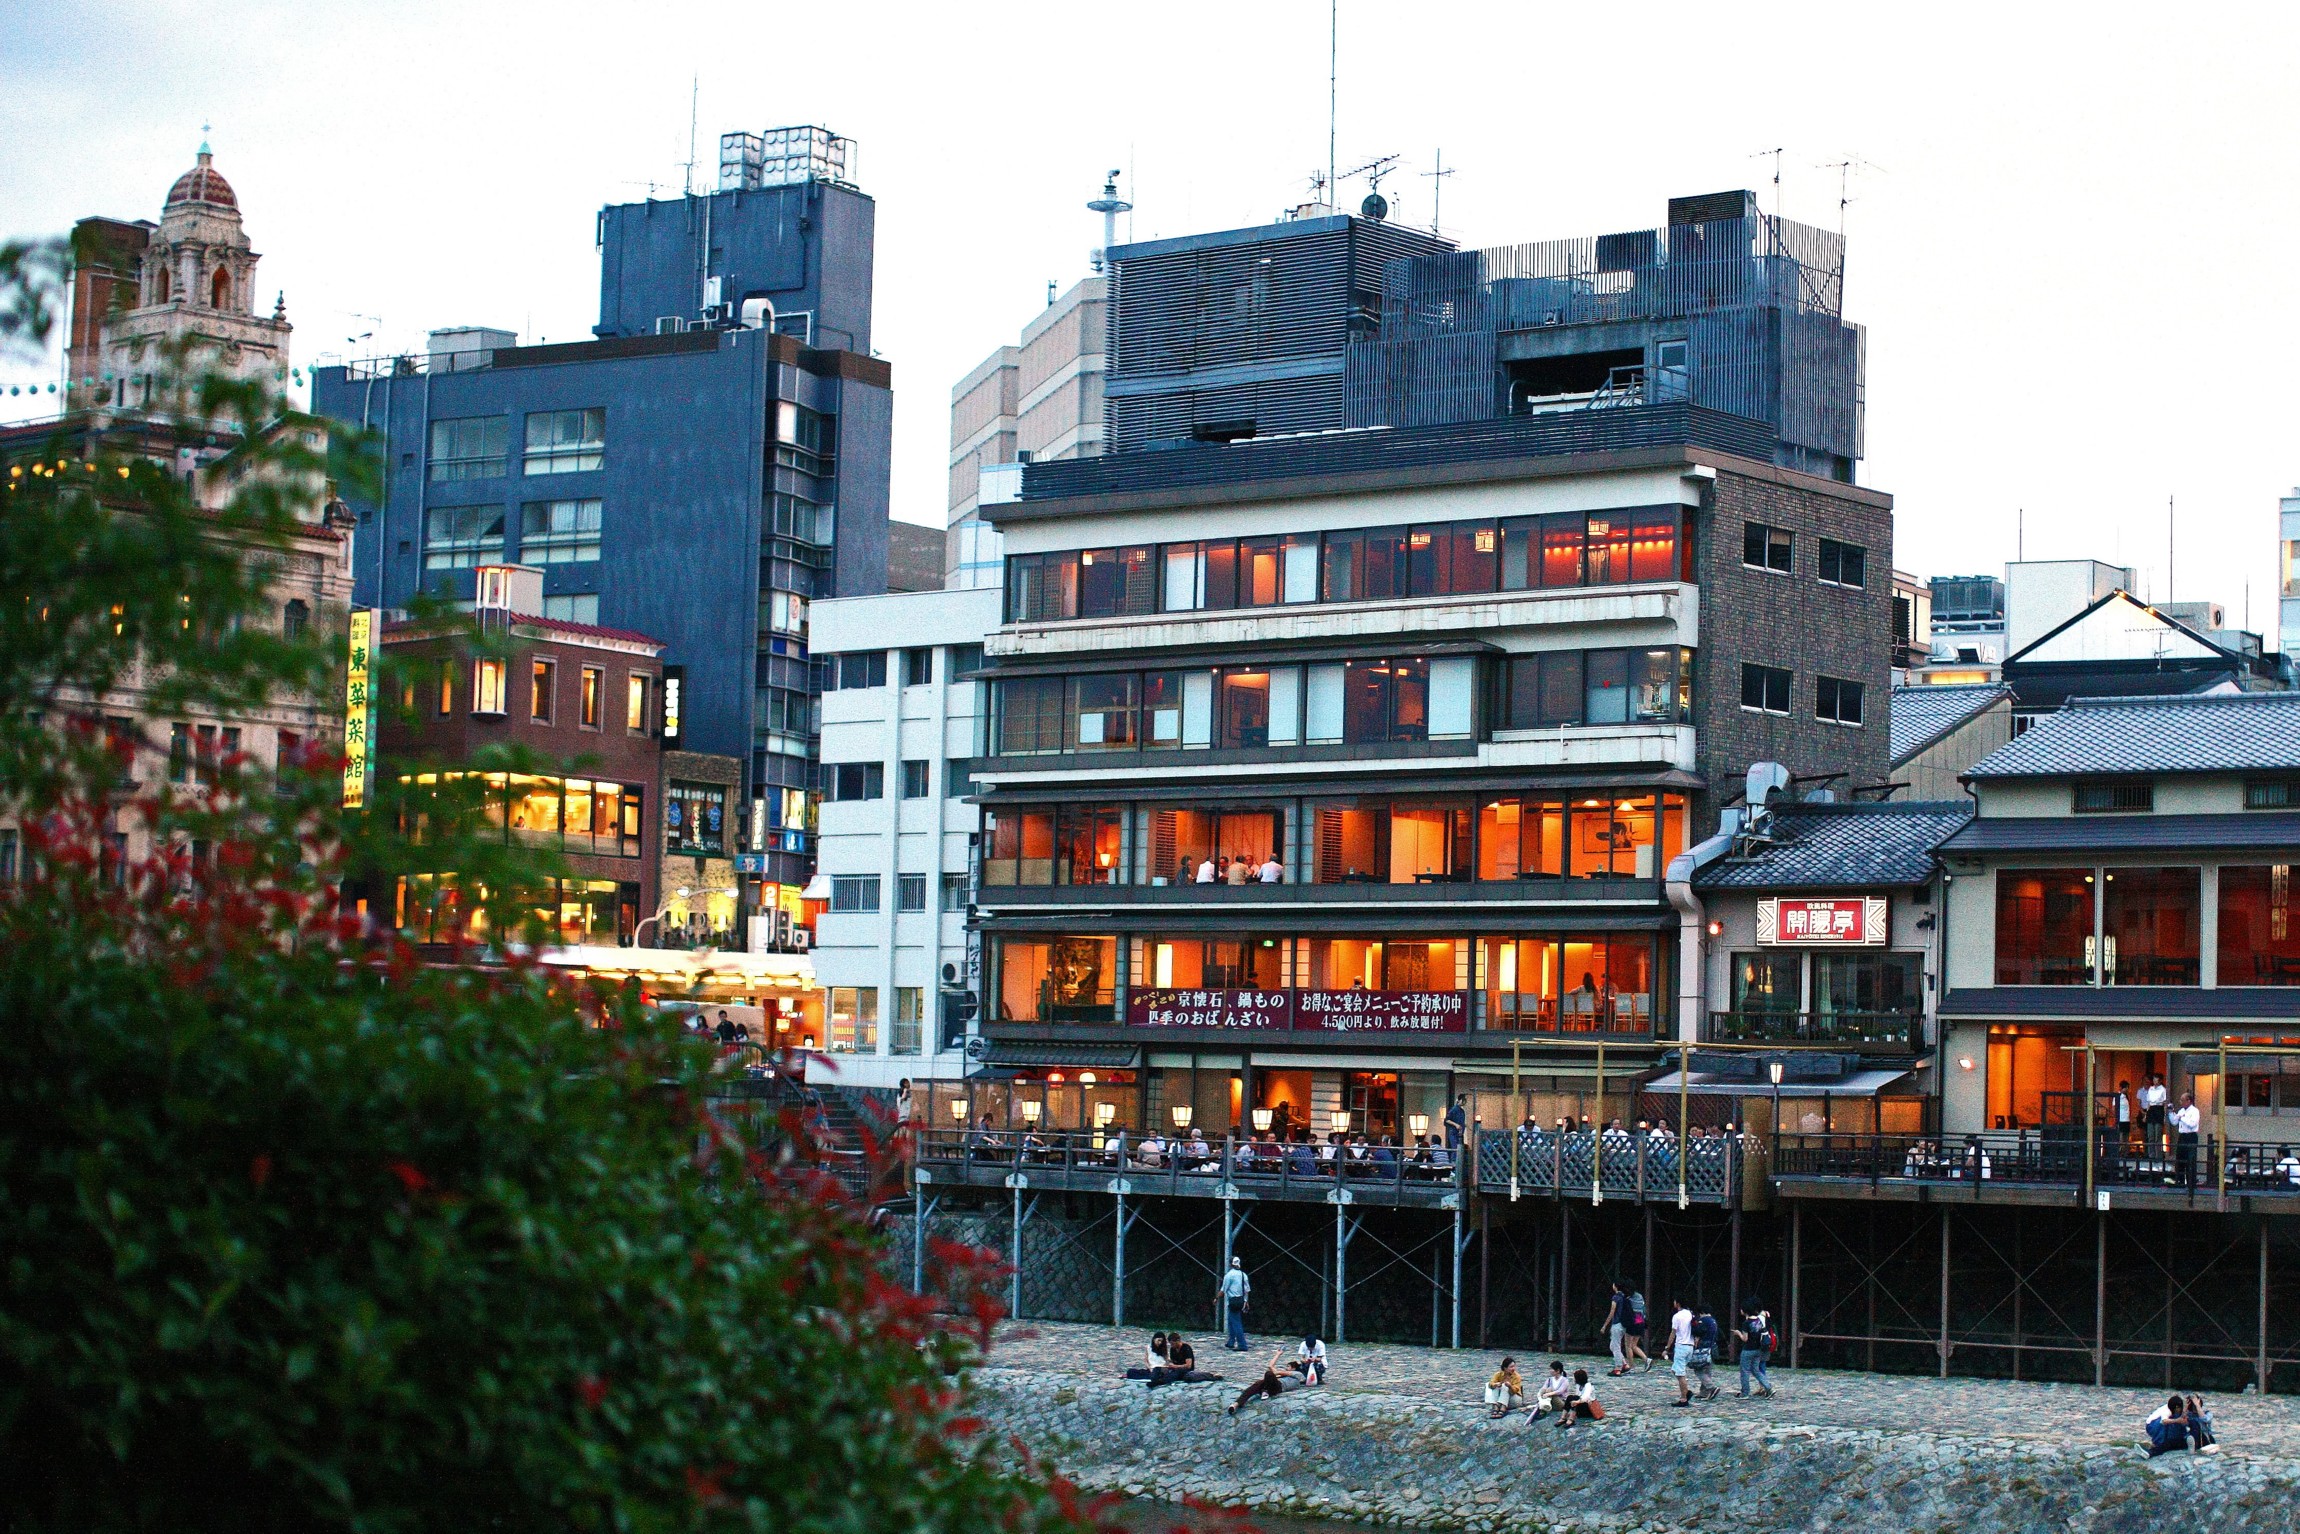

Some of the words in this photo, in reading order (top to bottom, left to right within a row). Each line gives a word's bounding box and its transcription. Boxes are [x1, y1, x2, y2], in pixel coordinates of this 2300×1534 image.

[345, 646, 367, 779] 東華菜館
[1787, 910, 1854, 933] 開陽亭
[1177, 991, 1285, 1009] 京懐石、鍋もの
